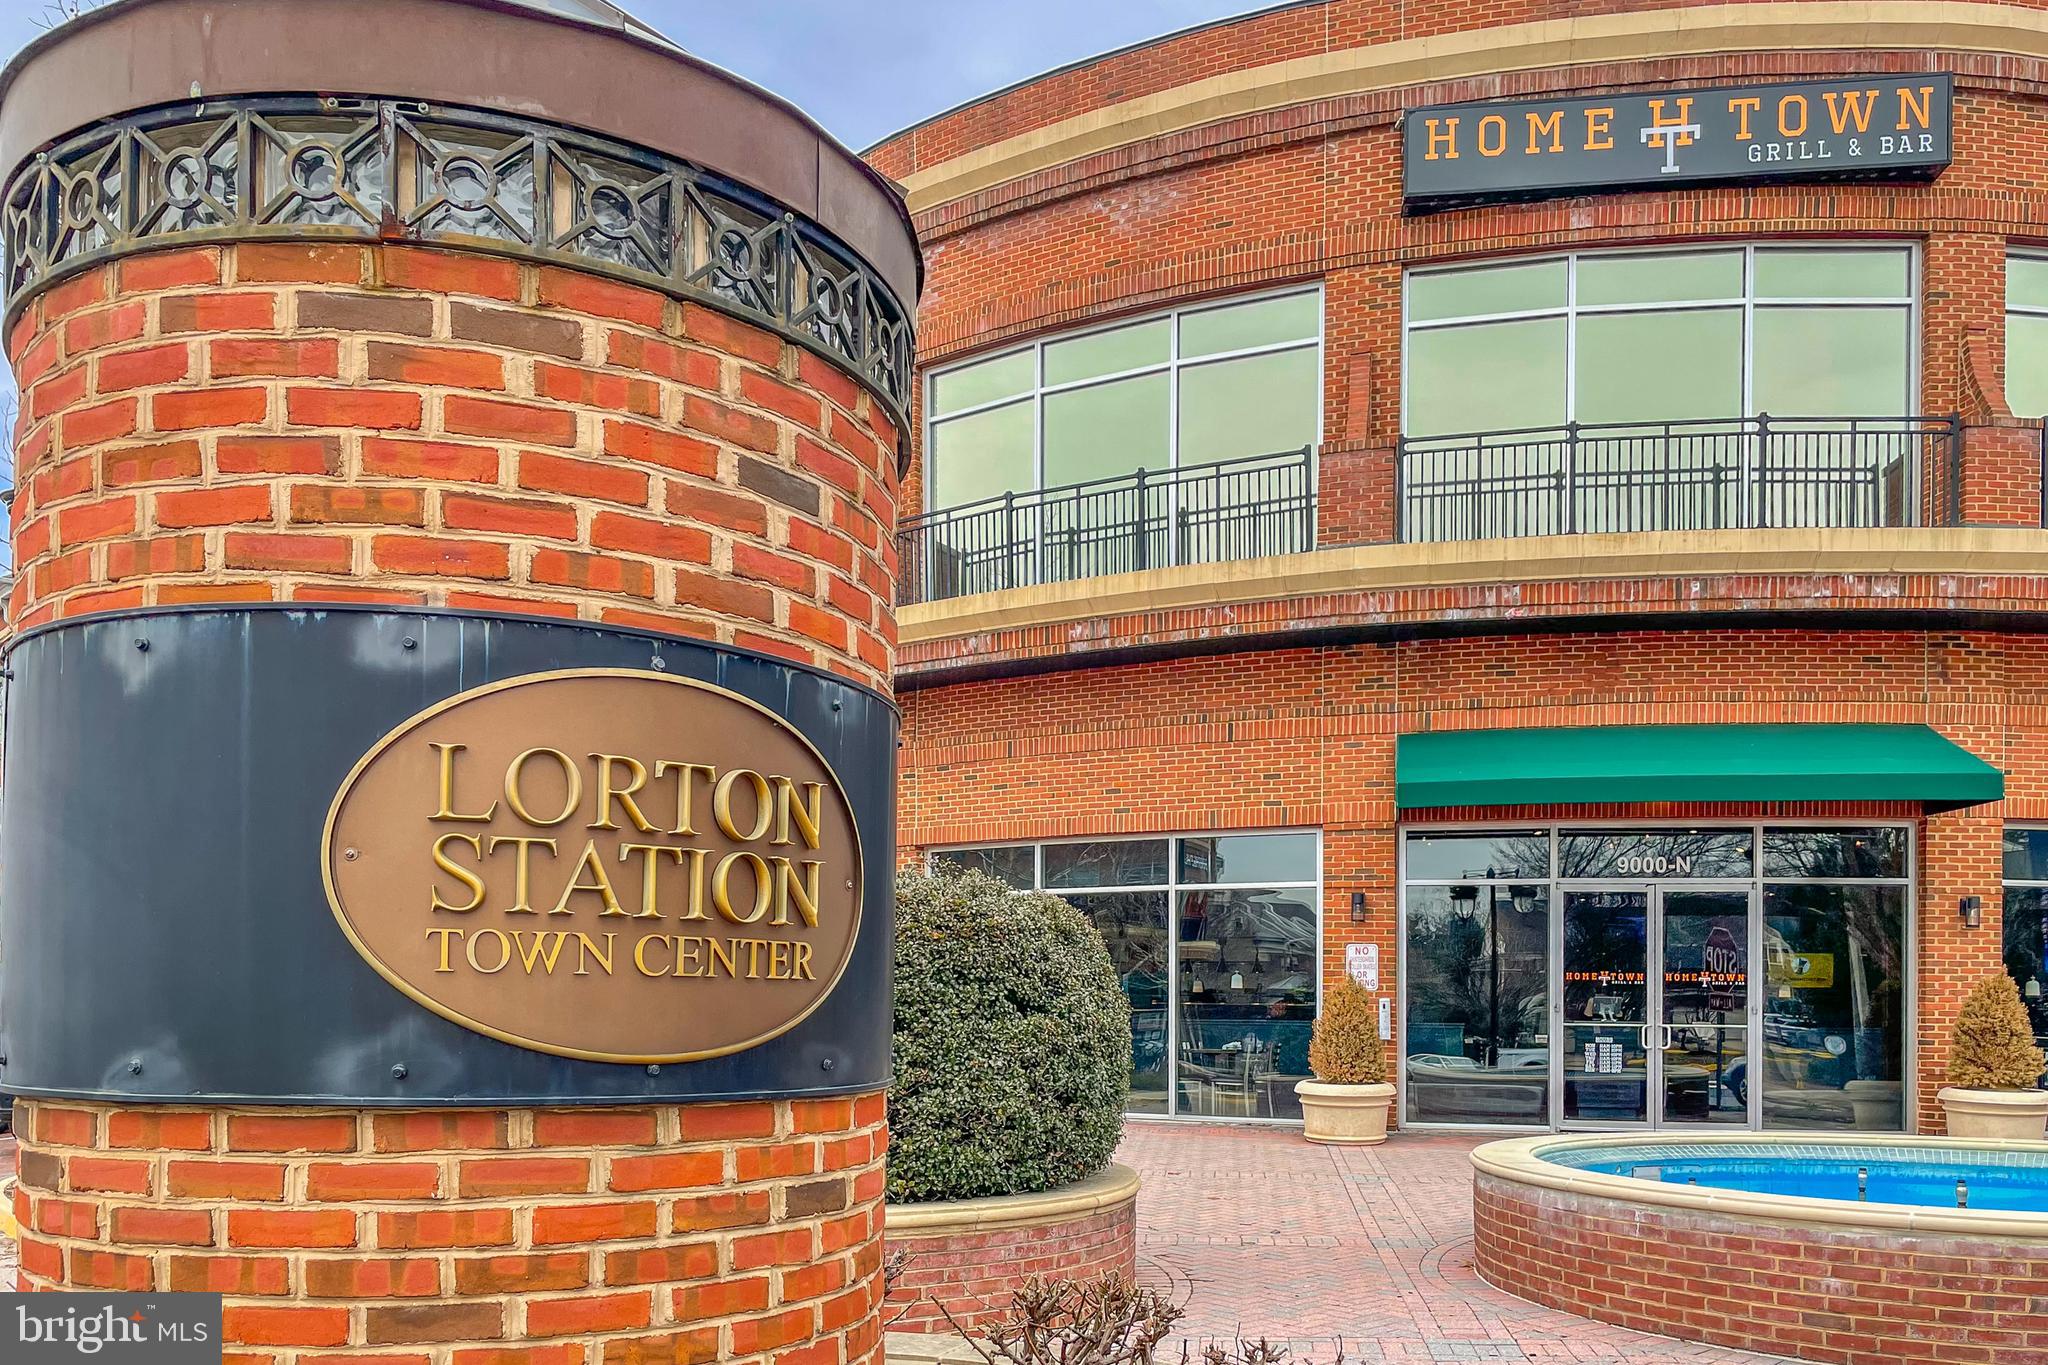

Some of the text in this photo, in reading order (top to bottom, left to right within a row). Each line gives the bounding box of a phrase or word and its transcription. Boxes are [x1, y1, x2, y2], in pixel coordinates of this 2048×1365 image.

[1424, 107, 1614, 161] HOME
[1728, 86, 1934, 141] TOWN
[1747, 133, 1934, 163] GRILL & BAR
[426, 742, 828, 849] LORTON
[1617, 856, 1691, 874] 9000-N
[430, 833, 827, 928] STATION
[425, 928, 817, 981] TOWN CENTER
[1354, 946, 1369, 955] NO
[1566, 972, 1598, 980] HOME
[1610, 972, 1644, 980] TOWN
[1665, 973, 1698, 982] HOME
[1711, 973, 1745, 982] TOWN
